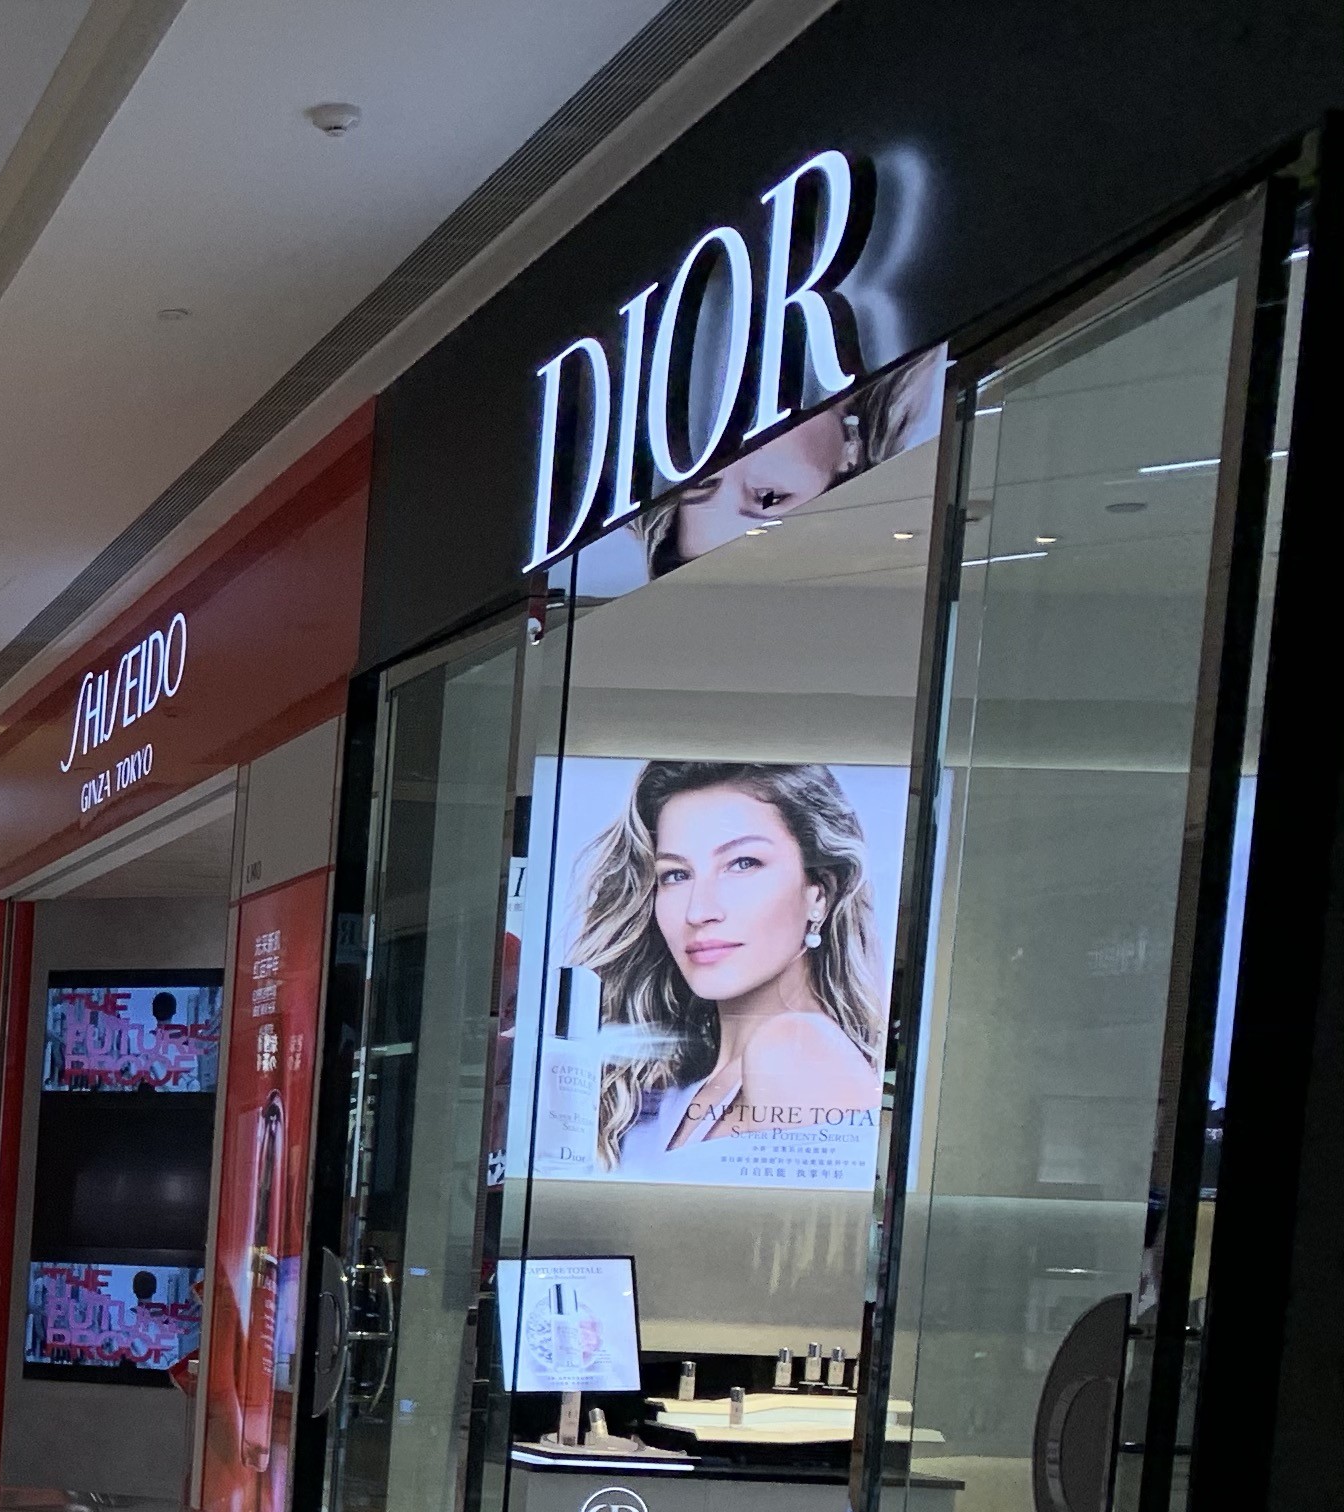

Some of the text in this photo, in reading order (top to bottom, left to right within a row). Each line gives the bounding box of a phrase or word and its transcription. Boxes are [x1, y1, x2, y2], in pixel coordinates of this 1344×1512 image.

[522, 149, 855, 574] DIOR
[60, 612, 187, 773] SHISEIDO
[81, 743, 153, 813] GINZA TOKYO
[686, 1103, 803, 1124] CAPTURE
